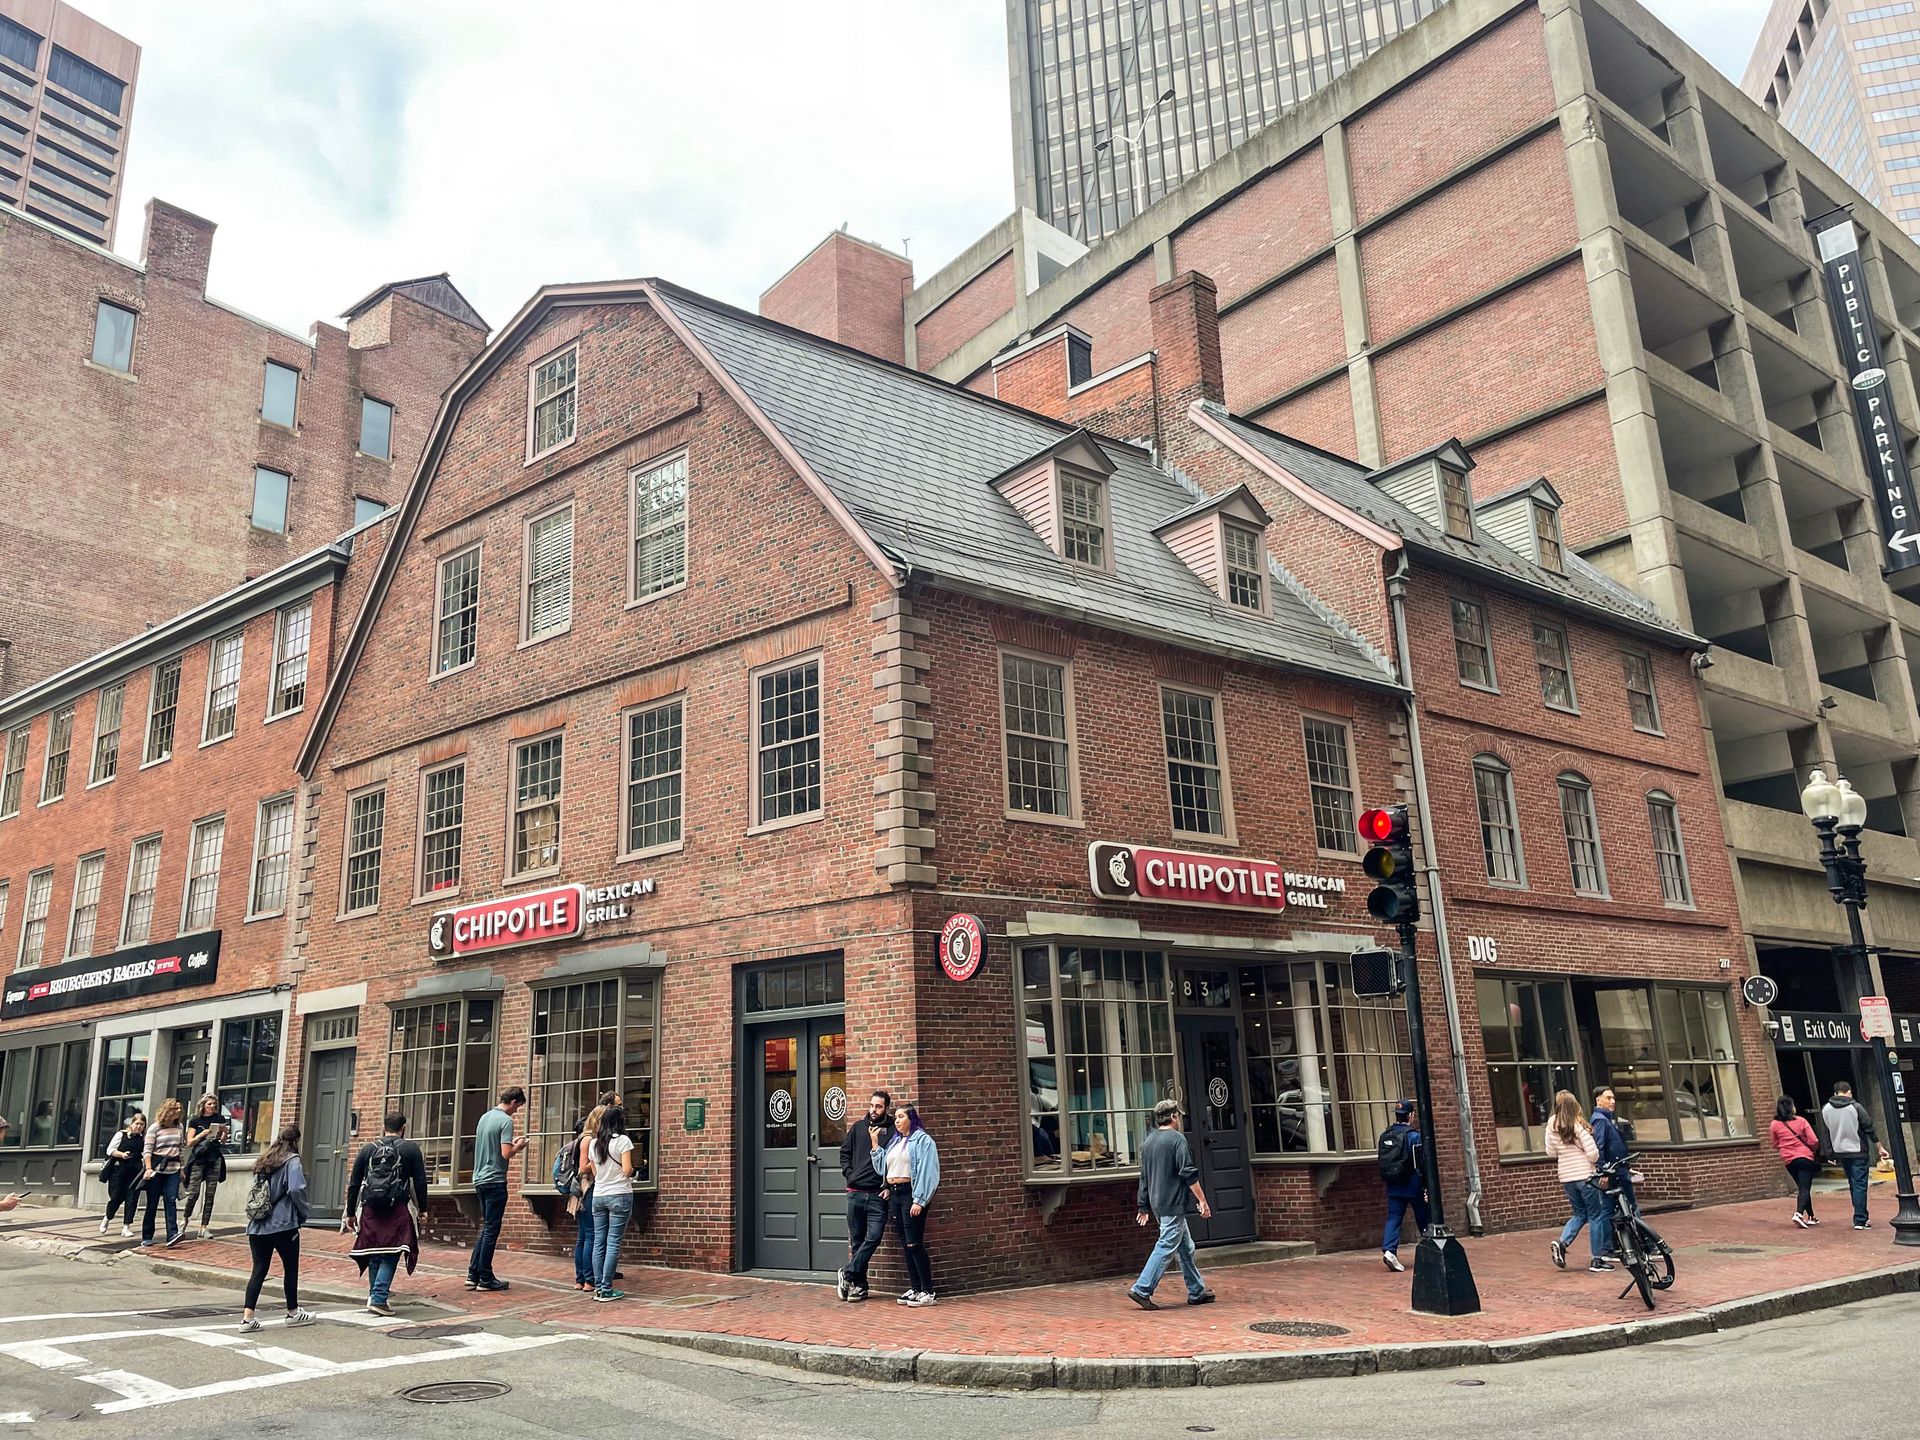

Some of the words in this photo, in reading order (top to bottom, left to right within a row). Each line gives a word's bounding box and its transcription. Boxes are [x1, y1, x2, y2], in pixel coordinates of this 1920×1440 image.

[1838, 264, 1871, 362] PUBLIC
[1868, 397, 1906, 519] PARKING
[586, 878, 654, 904] MEXICAN
[1146, 859, 1281, 897] CHIPOTLE
[1284, 871, 1345, 892] MEXICAN
[1286, 892, 1328, 908] GRILL
[455, 897, 567, 942] CHIPOTLE
[585, 903, 629, 924] GRILL
[941, 916, 978, 943] CHIPOTLE
[187, 951, 209, 969] Coffee
[1468, 936, 1497, 962] DIG
[49, 968, 112, 995] BRUEGGER'S
[112, 959, 156, 983] BAGELS
[942, 955, 965, 976] MEXICAN
[1803, 1020, 1826, 1038] Exit
[1828, 1020, 1851, 1043] Only
